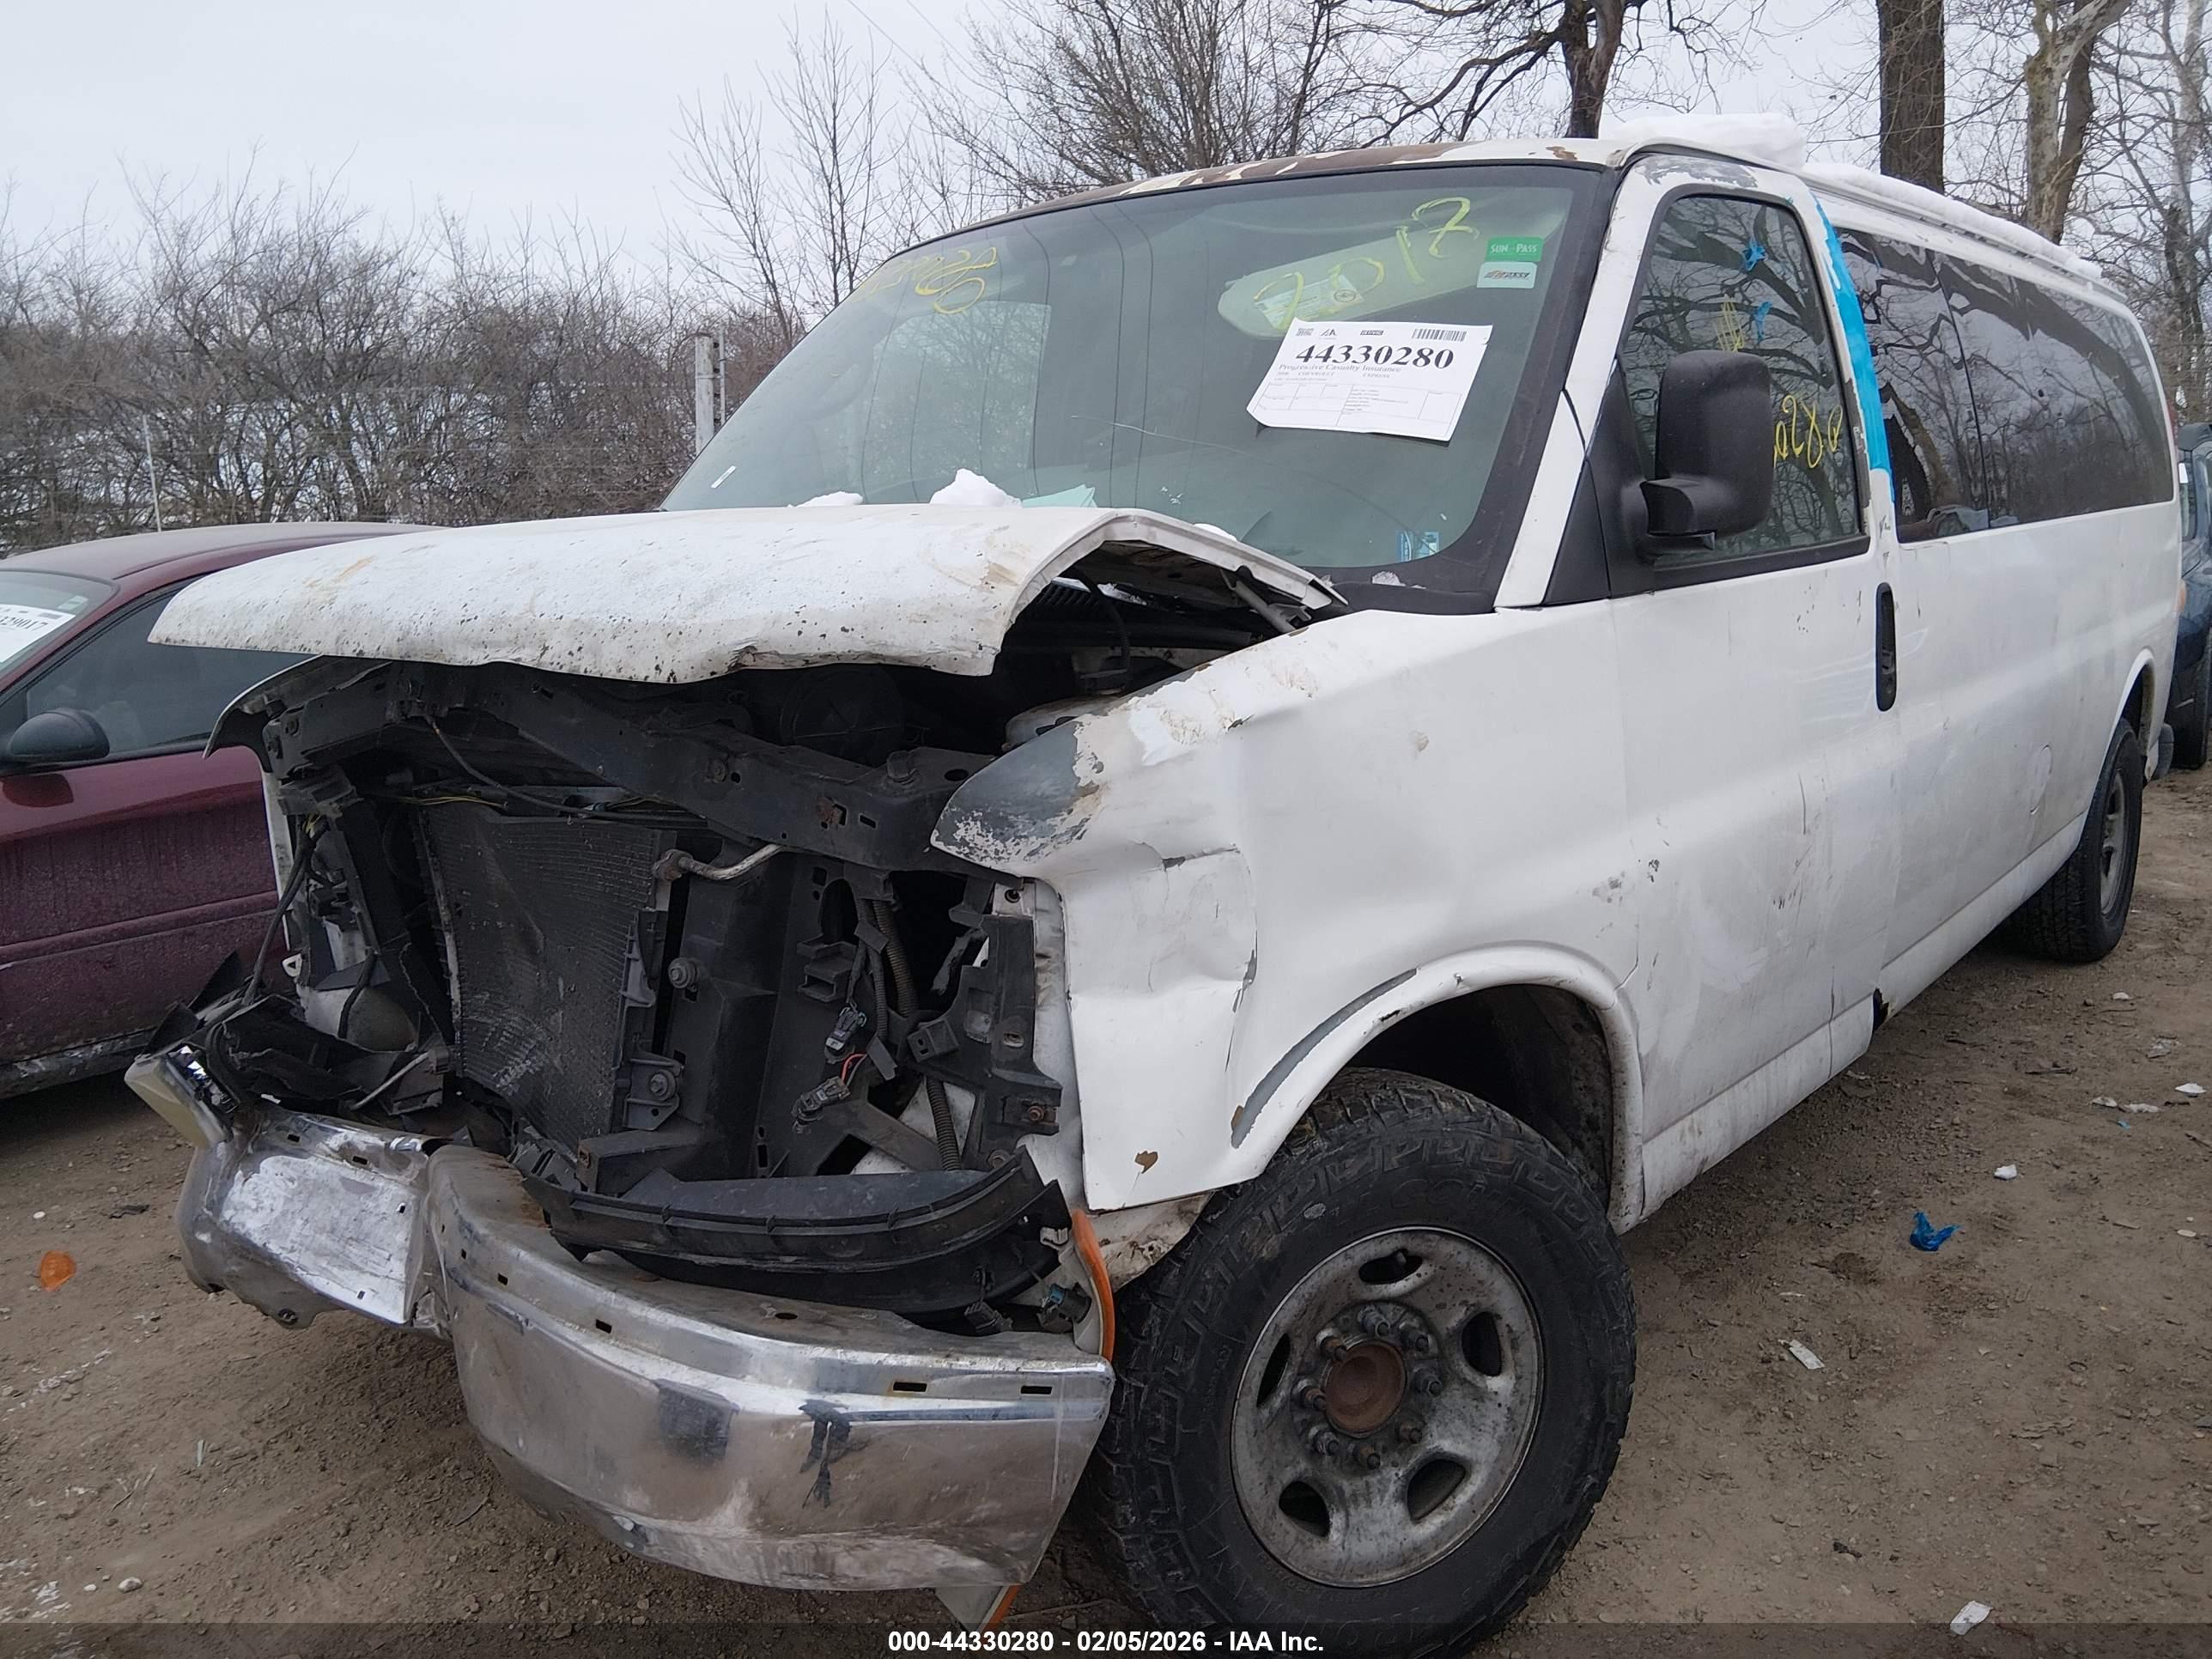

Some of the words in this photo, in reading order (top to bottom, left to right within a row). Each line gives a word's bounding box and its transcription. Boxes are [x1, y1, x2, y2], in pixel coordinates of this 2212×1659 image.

[1516, 243, 1538, 253] PASS
[1296, 344, 1454, 368] 44330280
[1363, 364, 1401, 373] Insurance
